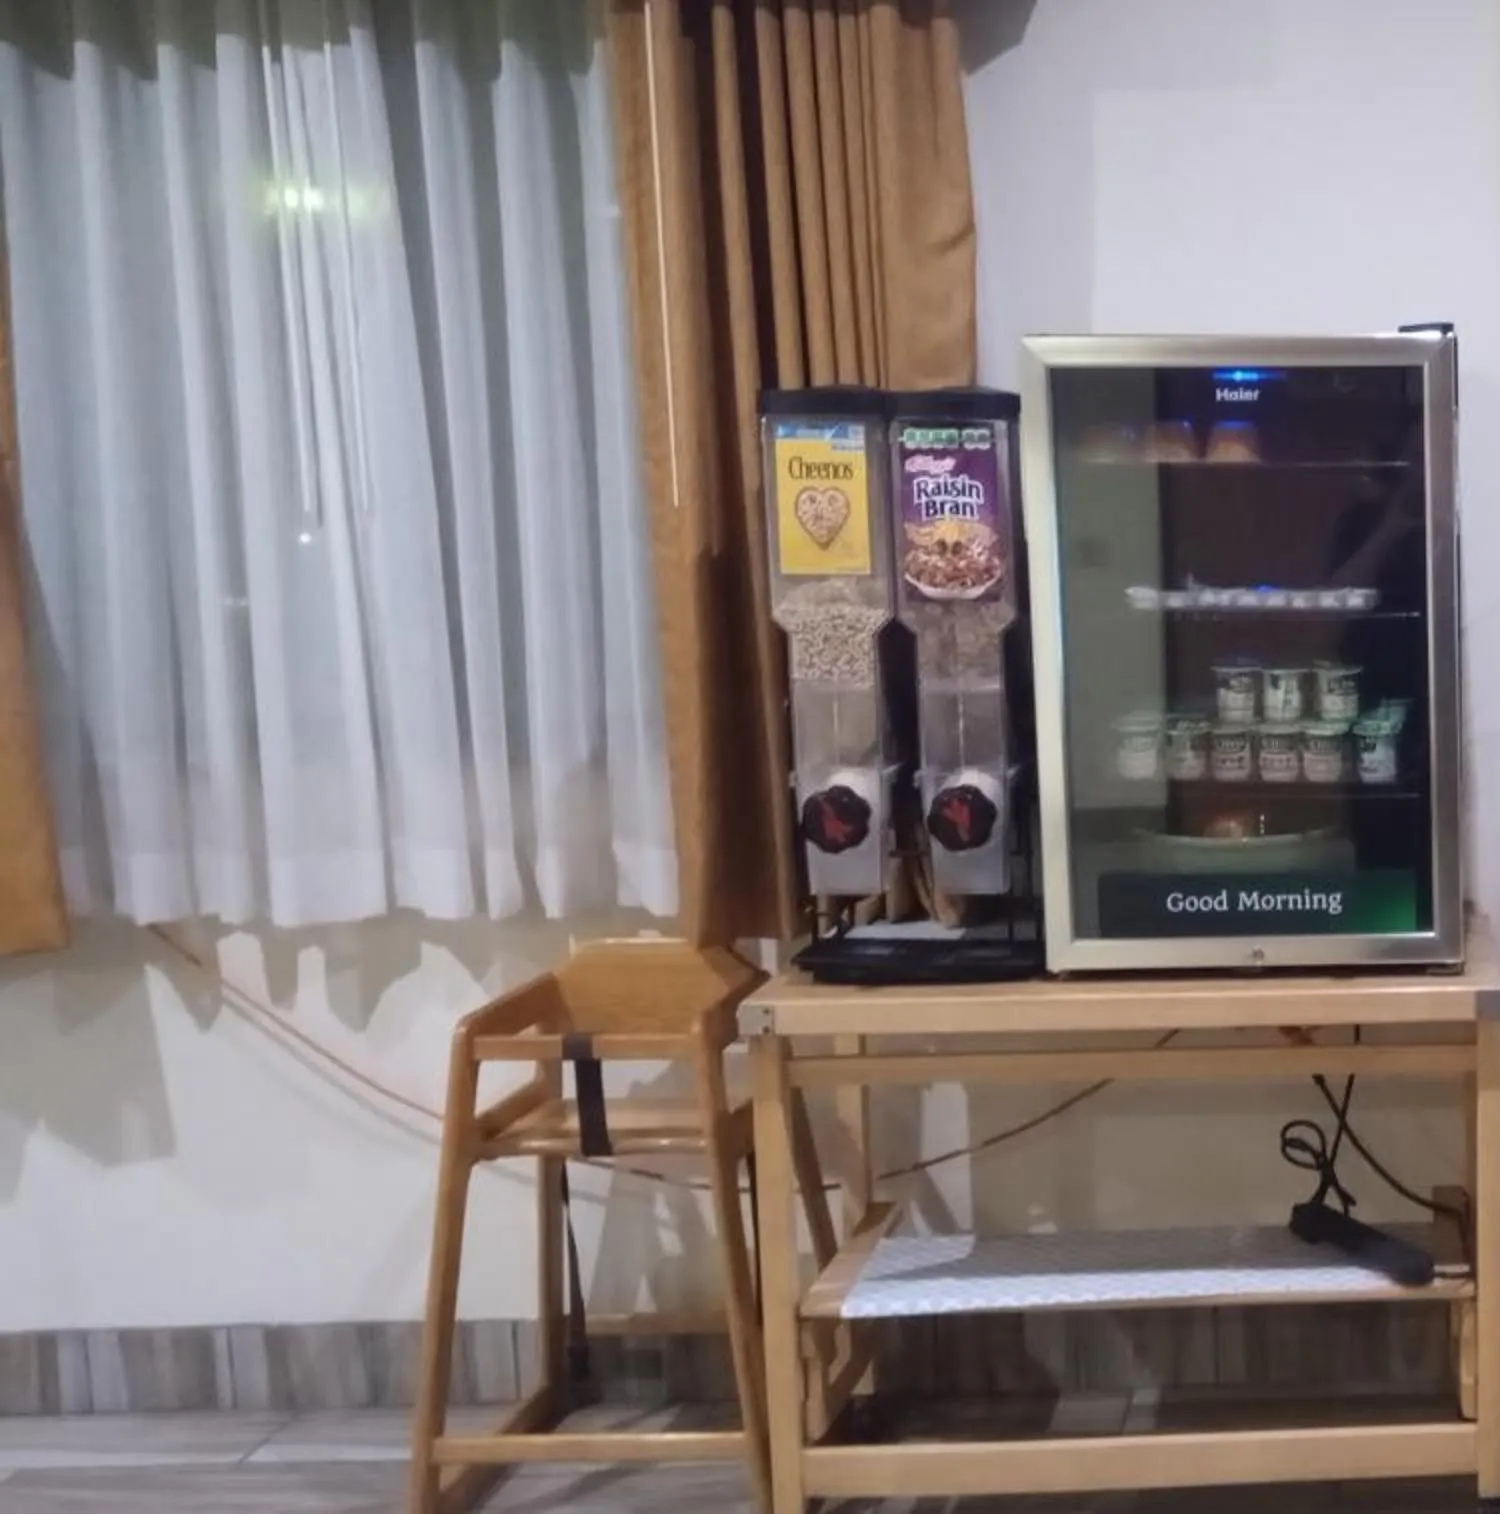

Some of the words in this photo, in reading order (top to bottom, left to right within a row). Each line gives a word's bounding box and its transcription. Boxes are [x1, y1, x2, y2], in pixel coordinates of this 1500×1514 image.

[915, 476, 982, 500] Raisin
[923, 499, 978, 519] Bran
[1166, 889, 1229, 913] Good
[1237, 888, 1343, 915] Morning
